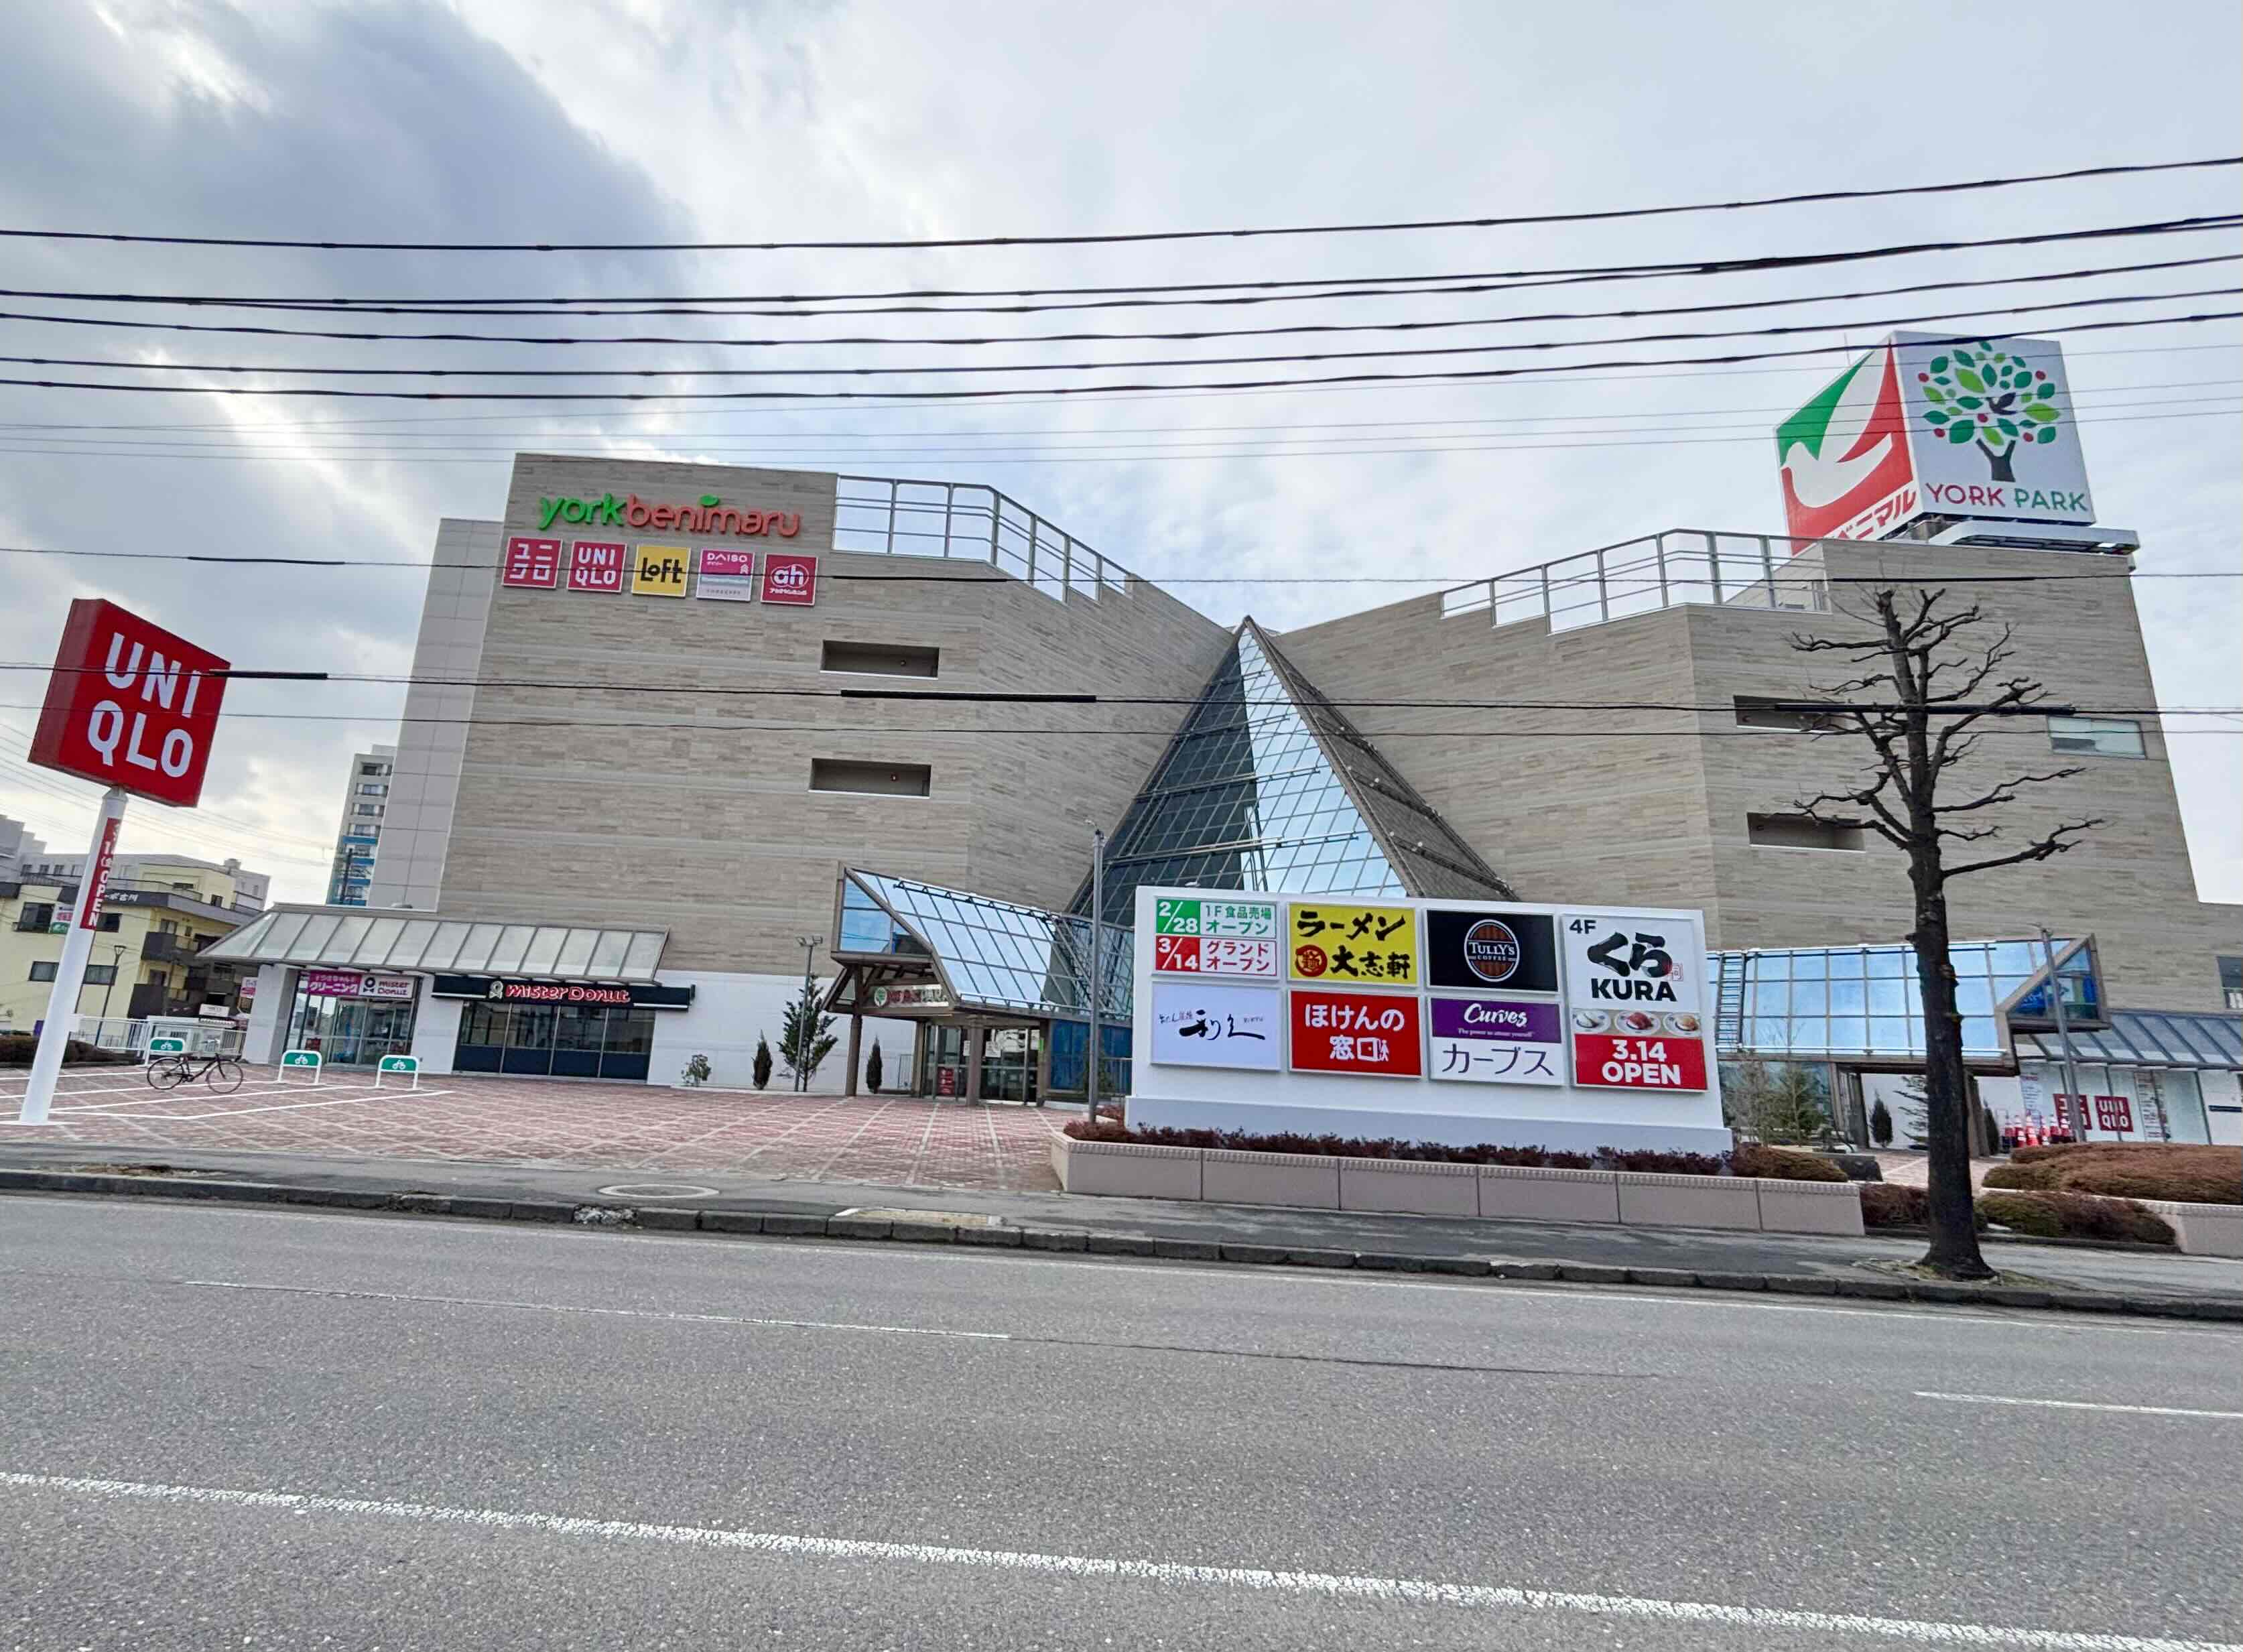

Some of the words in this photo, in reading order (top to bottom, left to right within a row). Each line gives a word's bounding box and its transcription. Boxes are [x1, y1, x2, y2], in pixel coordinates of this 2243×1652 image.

[1925, 482, 2006, 508] YORK
[2013, 487, 2089, 512] PARK
[514, 543, 553, 561] ユニ
[578, 546, 615, 566] UNI
[707, 552, 748, 563] DAISO
[574, 566, 617, 586] QLO
[774, 565, 804, 585] ah
[105, 631, 201, 719] UNI
[88, 699, 193, 778] QLO
[1159, 901, 1198, 933] 2/28
[1206, 919, 1269, 935] オープン
[1297, 909, 1406, 942] ラーメン
[1569, 919, 1597, 934] 4F
[1158, 938, 1198, 970] 3/14
[1206, 940, 1269, 958] グランド
[1587, 932, 1673, 978] くら
[1206, 956, 1270, 972] オープン
[1330, 944, 1411, 980] 大志軒
[309, 981, 359, 995] クリーニング
[1590, 977, 1678, 1003] KURA
[1305, 1003, 1405, 1032] ほけんの
[1464, 1003, 1528, 1028] Curves
[1329, 1034, 1384, 1062] 窓口
[1442, 1043, 1555, 1076] カーブス
[1612, 1039, 1667, 1062] 3.14
[1601, 1061, 1681, 1086] OPEN
